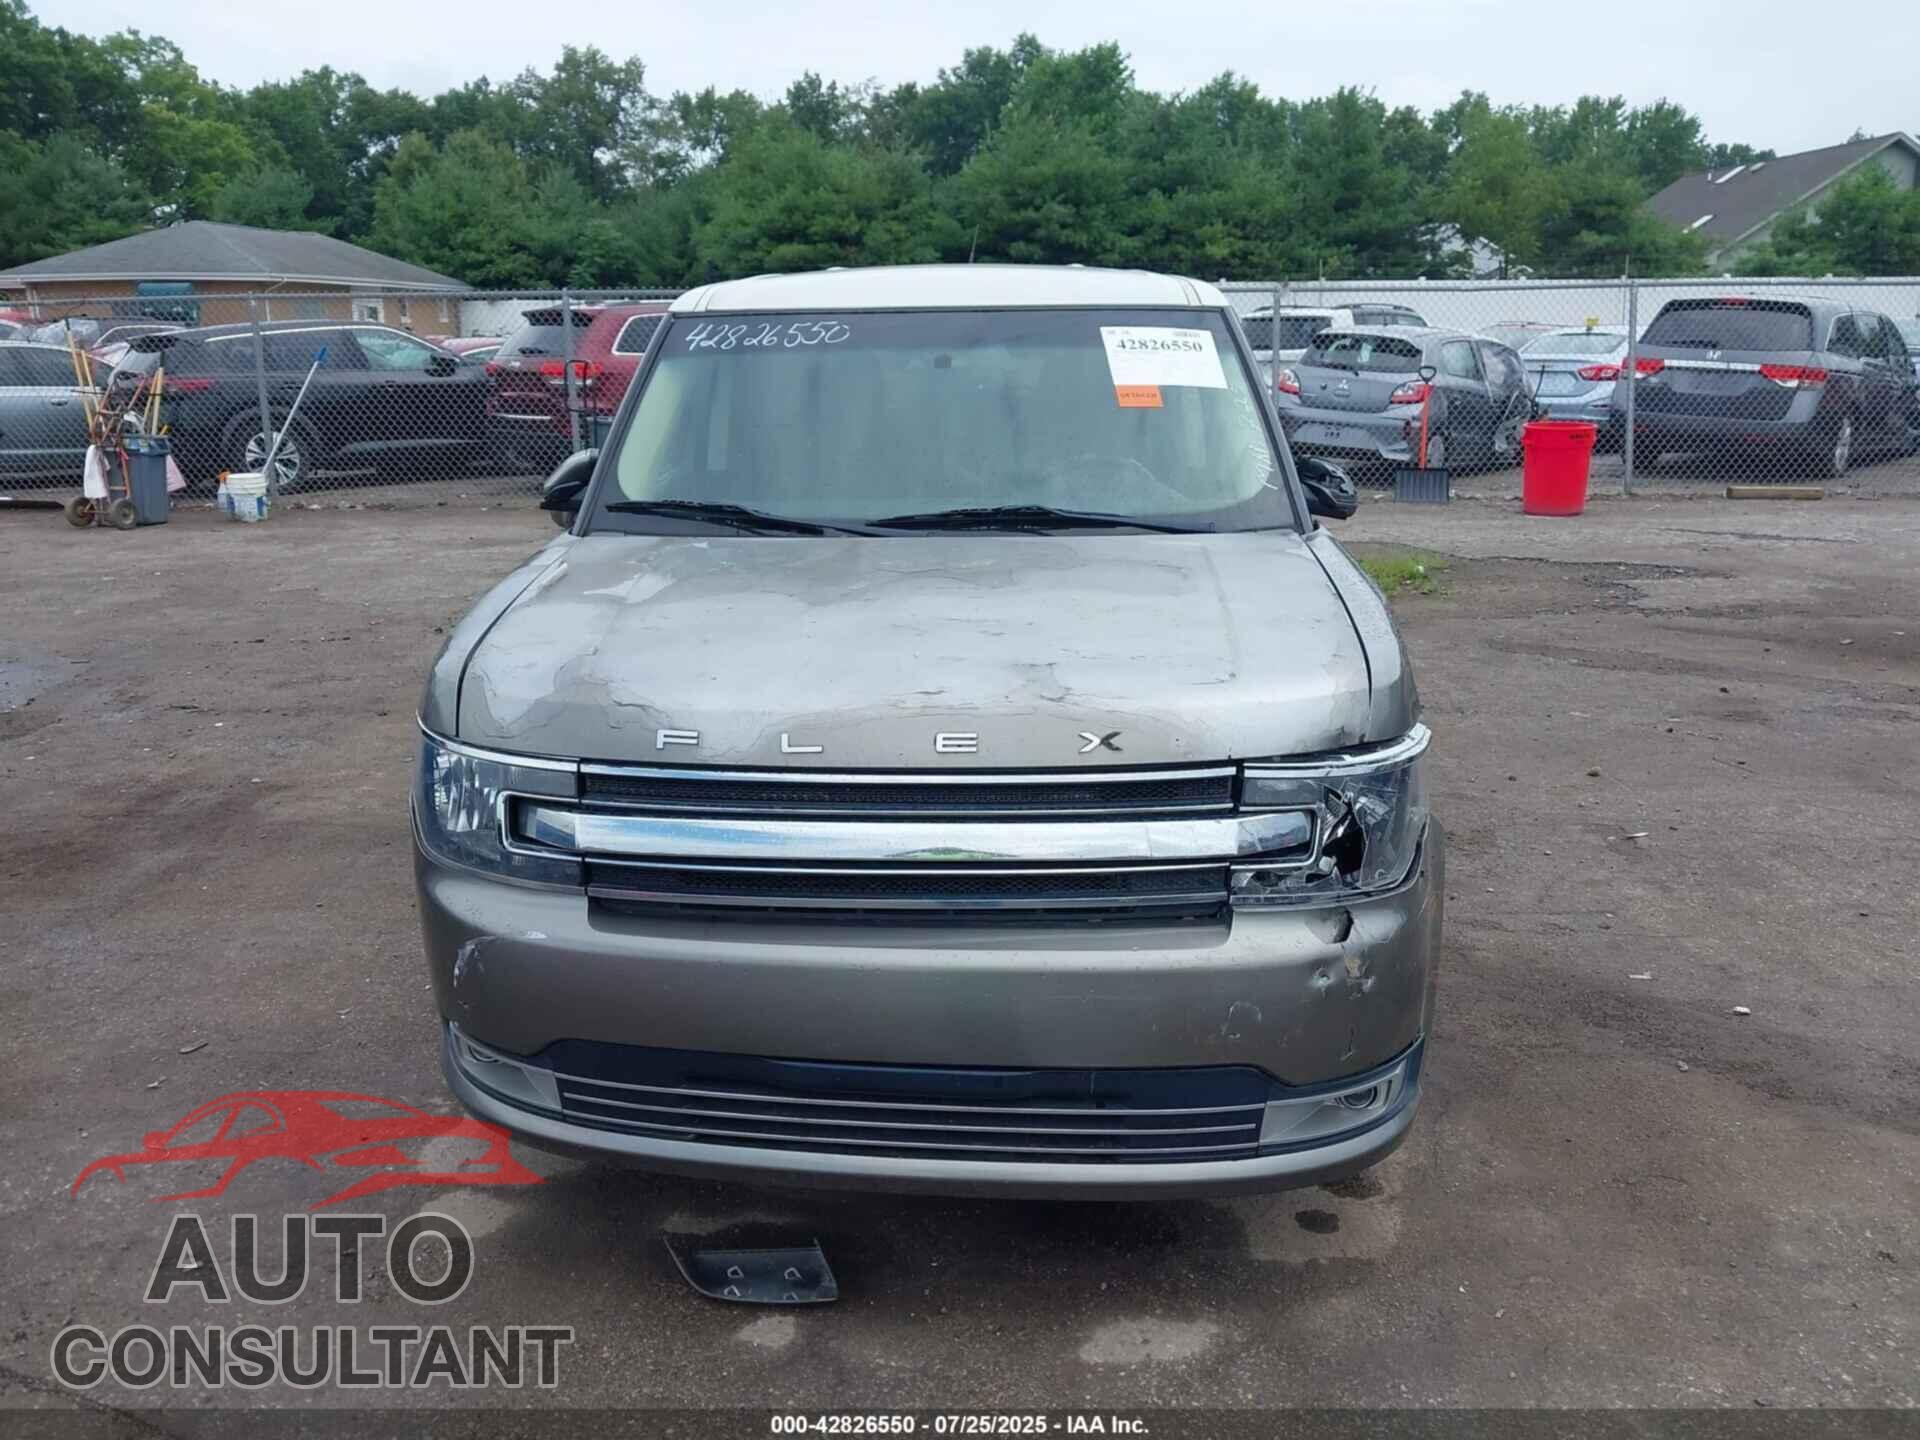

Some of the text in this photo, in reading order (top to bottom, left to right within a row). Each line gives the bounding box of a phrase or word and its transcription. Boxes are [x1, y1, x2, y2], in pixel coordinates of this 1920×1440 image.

[685, 321, 851, 351] 42826550
[1115, 338, 1203, 353] 42826550
[656, 728, 1123, 754] FLEX
